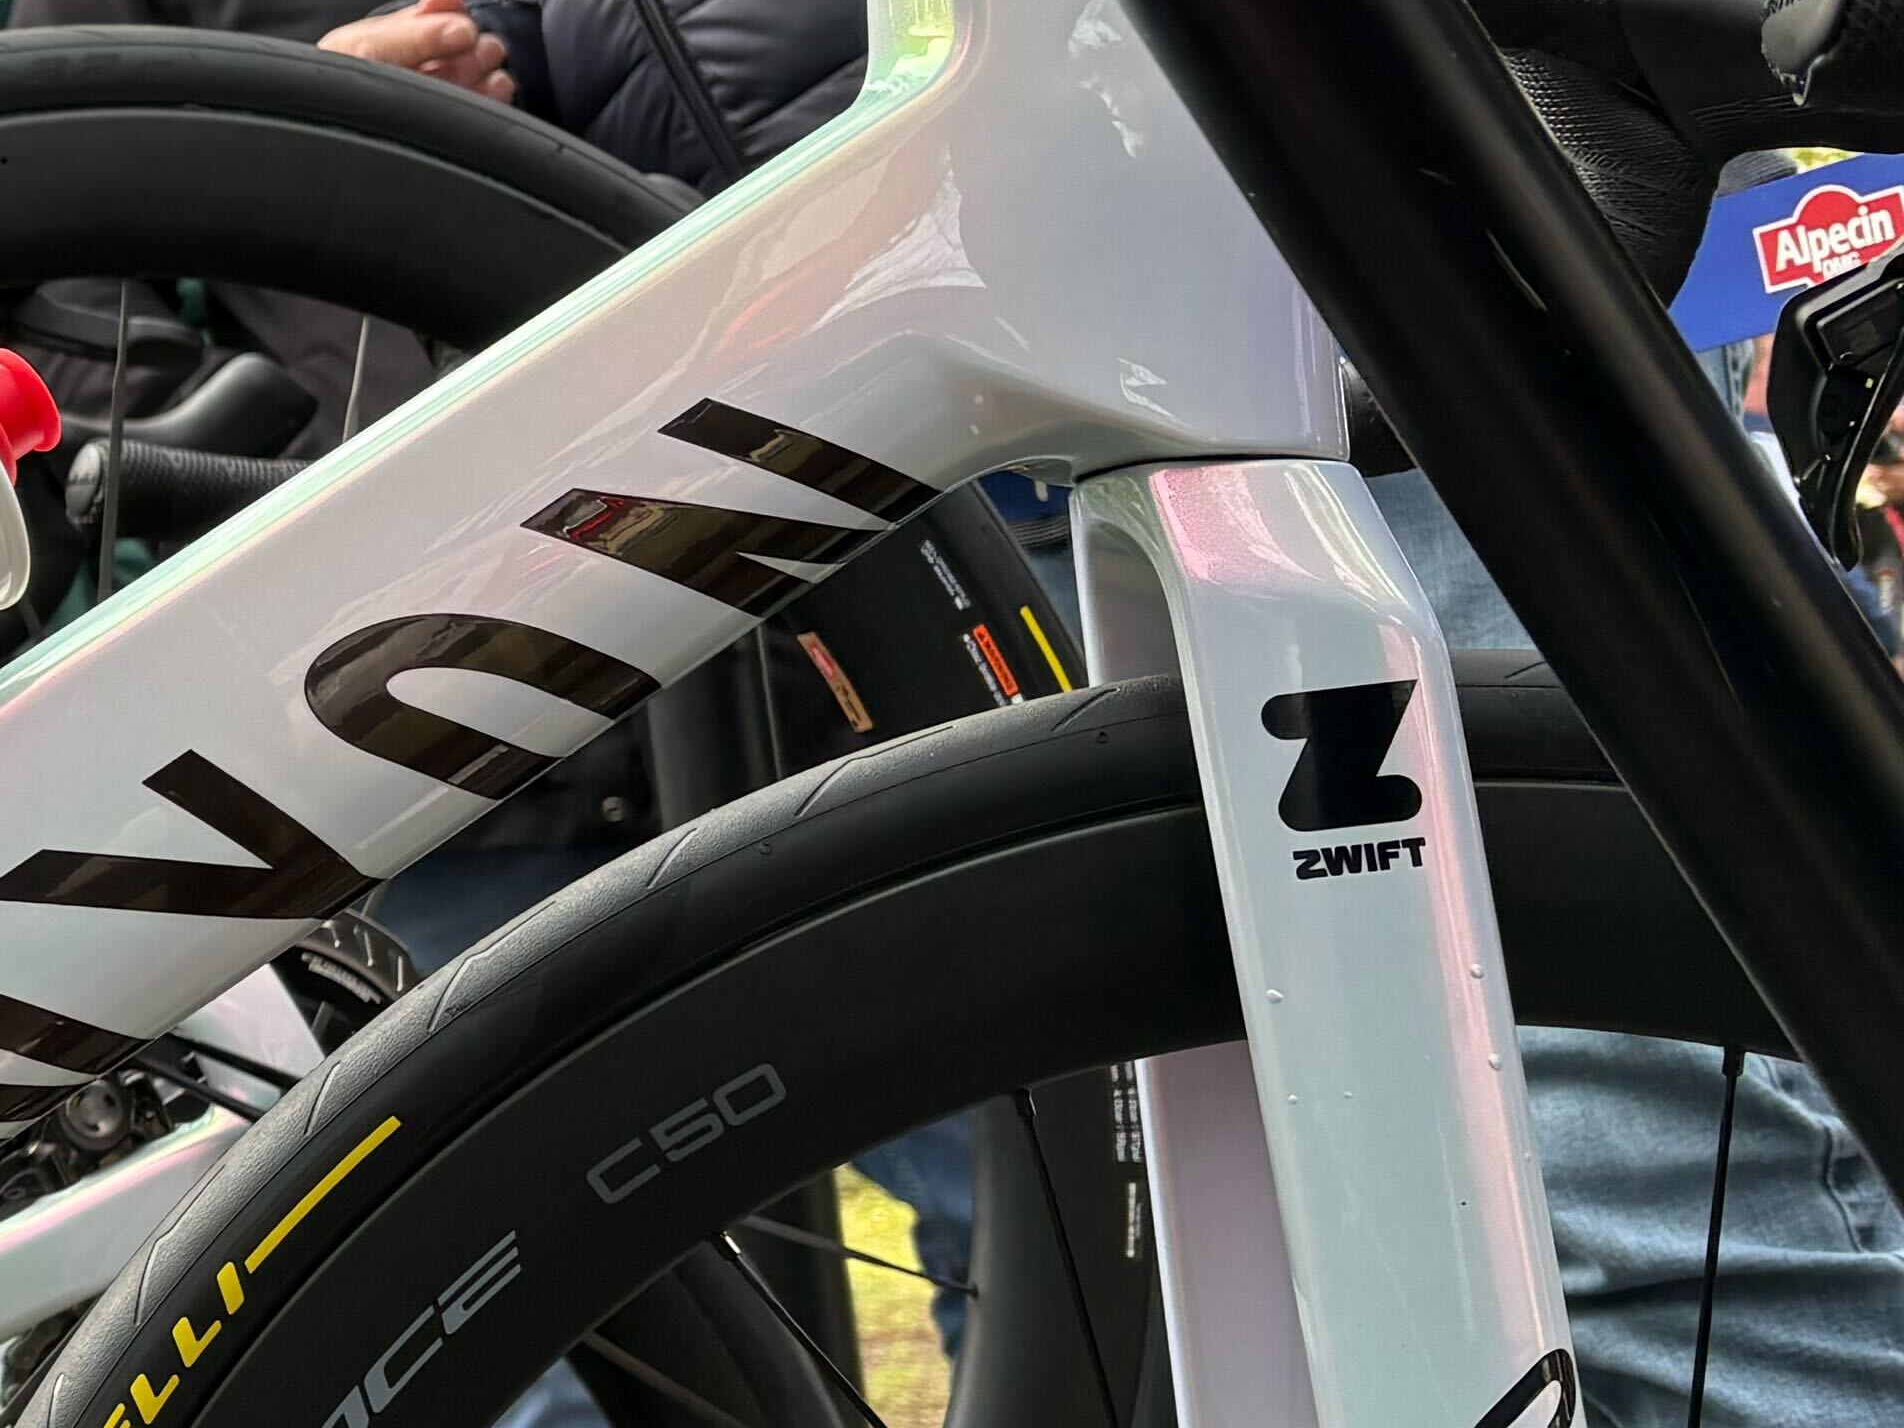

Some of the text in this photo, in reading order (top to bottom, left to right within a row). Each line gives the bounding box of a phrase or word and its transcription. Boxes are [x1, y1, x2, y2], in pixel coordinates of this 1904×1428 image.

[1774, 204, 1897, 274] Alpecin
[1292, 837, 1427, 883] ZWIFT
[586, 1060, 788, 1207] C50
